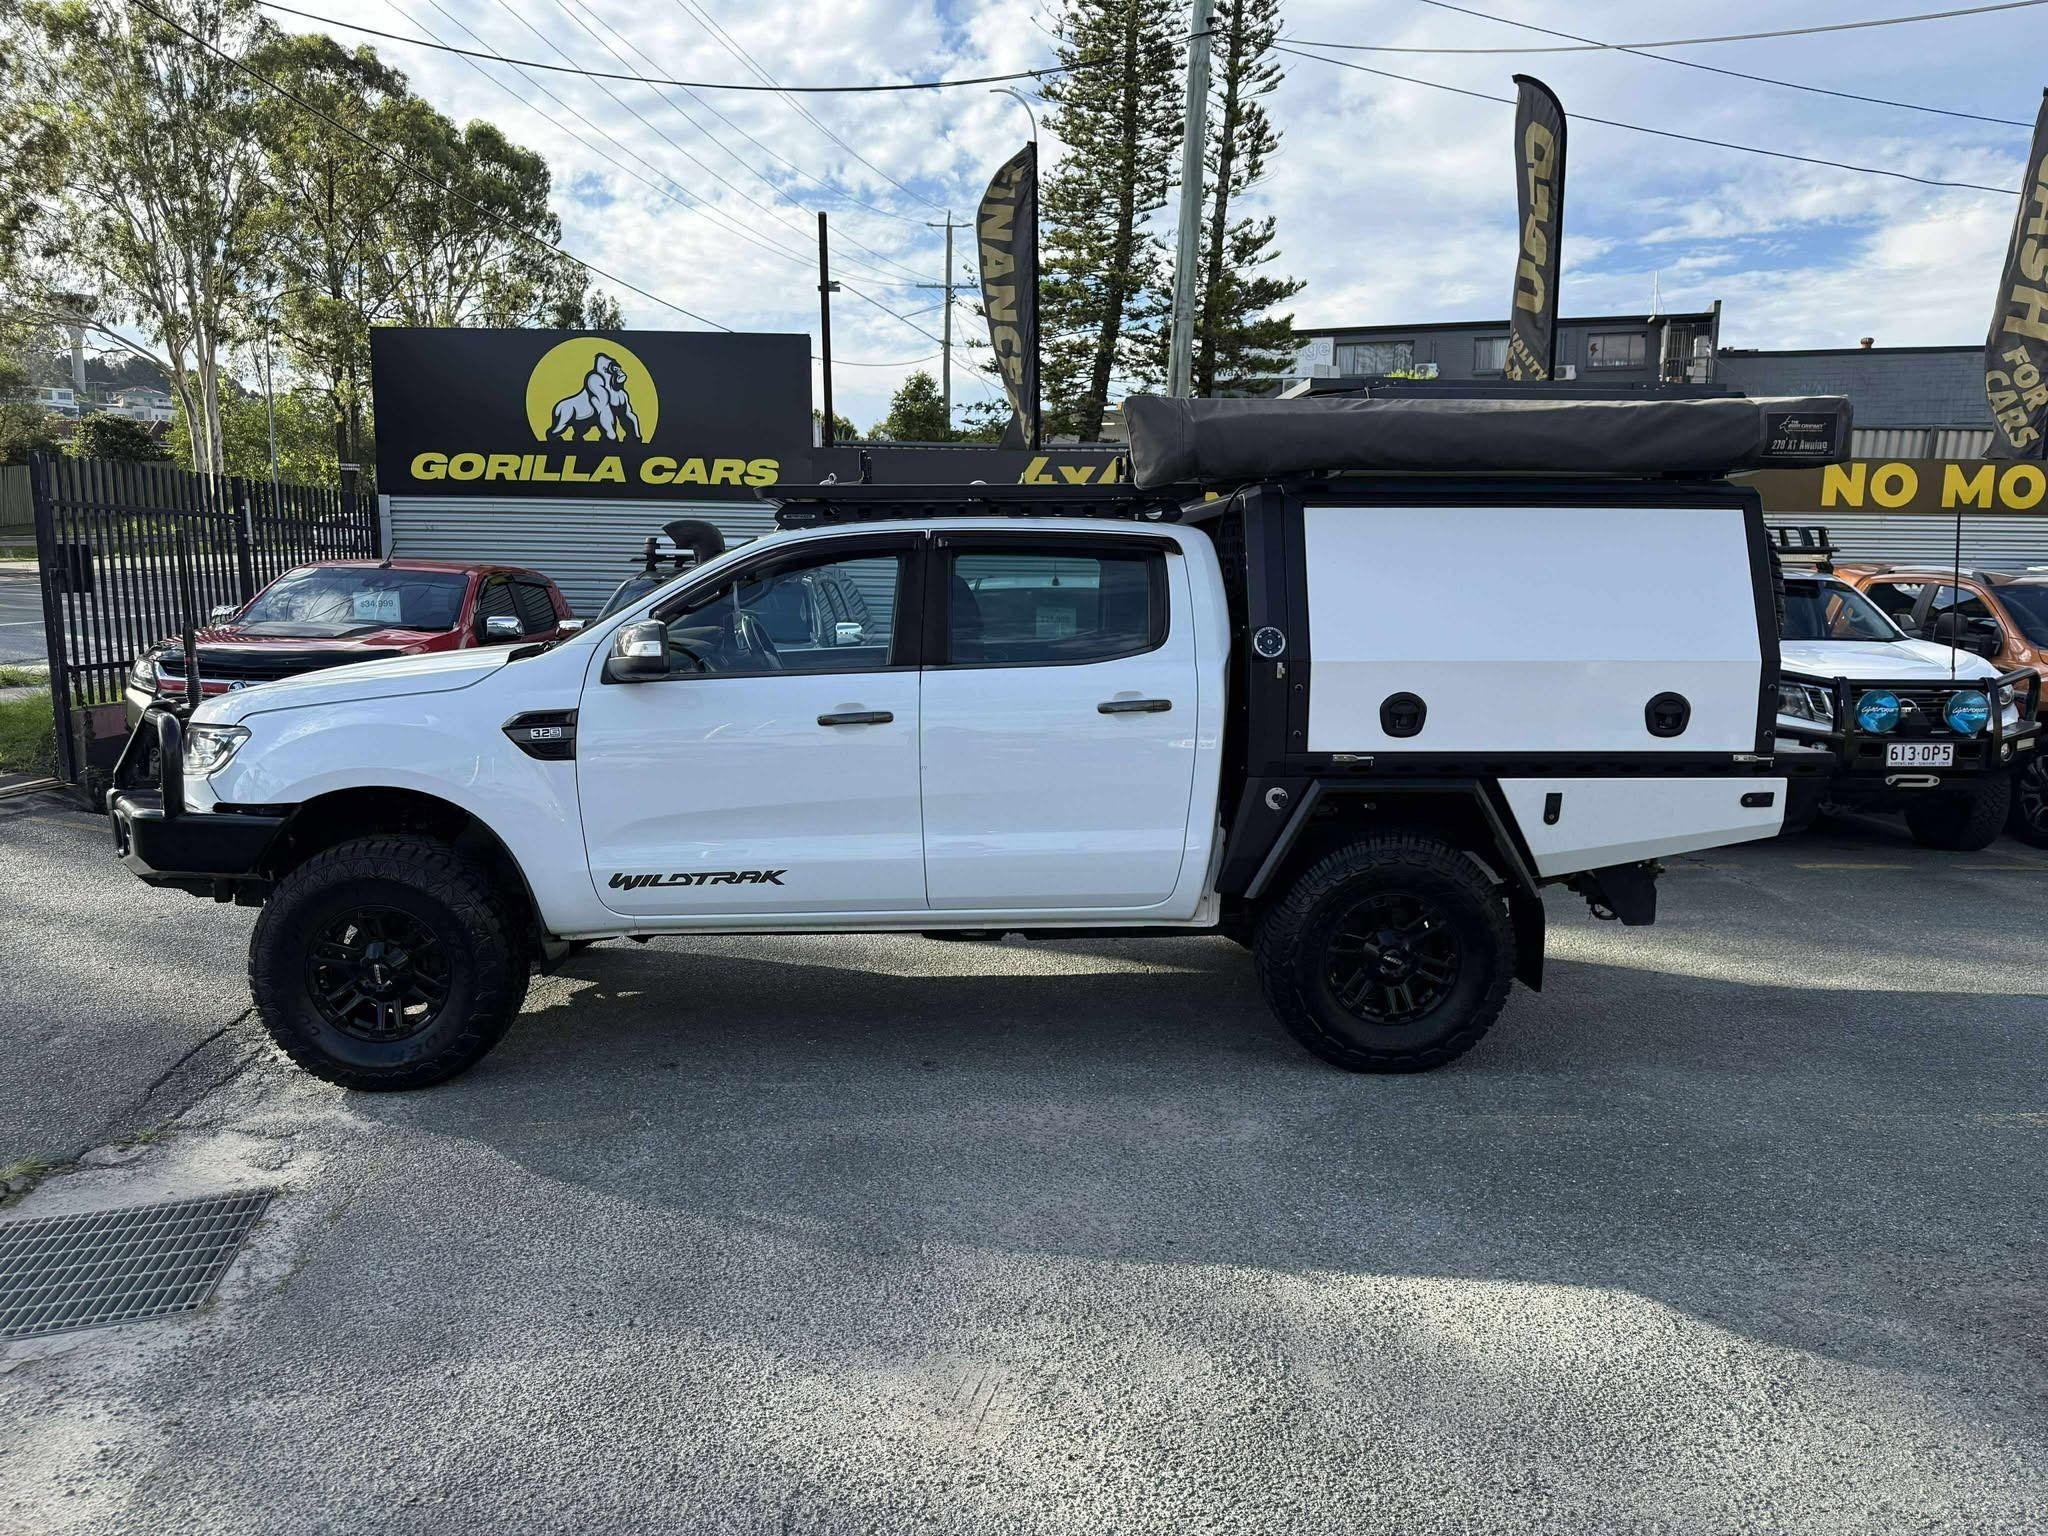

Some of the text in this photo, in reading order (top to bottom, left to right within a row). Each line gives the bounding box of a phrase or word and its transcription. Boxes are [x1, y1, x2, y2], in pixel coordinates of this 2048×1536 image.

[1516, 121, 1554, 314] USED
[981, 164, 1024, 385] FINANCE
[1512, 328, 1548, 381] UALITY
[2002, 345, 2048, 412] FOR
[1986, 370, 2040, 447] CARS
[411, 453, 780, 487] GORILLA CARS
[1786, 440, 1797, 450] XT
[1799, 439, 1828, 452] Awning
[1821, 463, 1919, 508] NO
[608, 870, 788, 891] WILDTRAK
